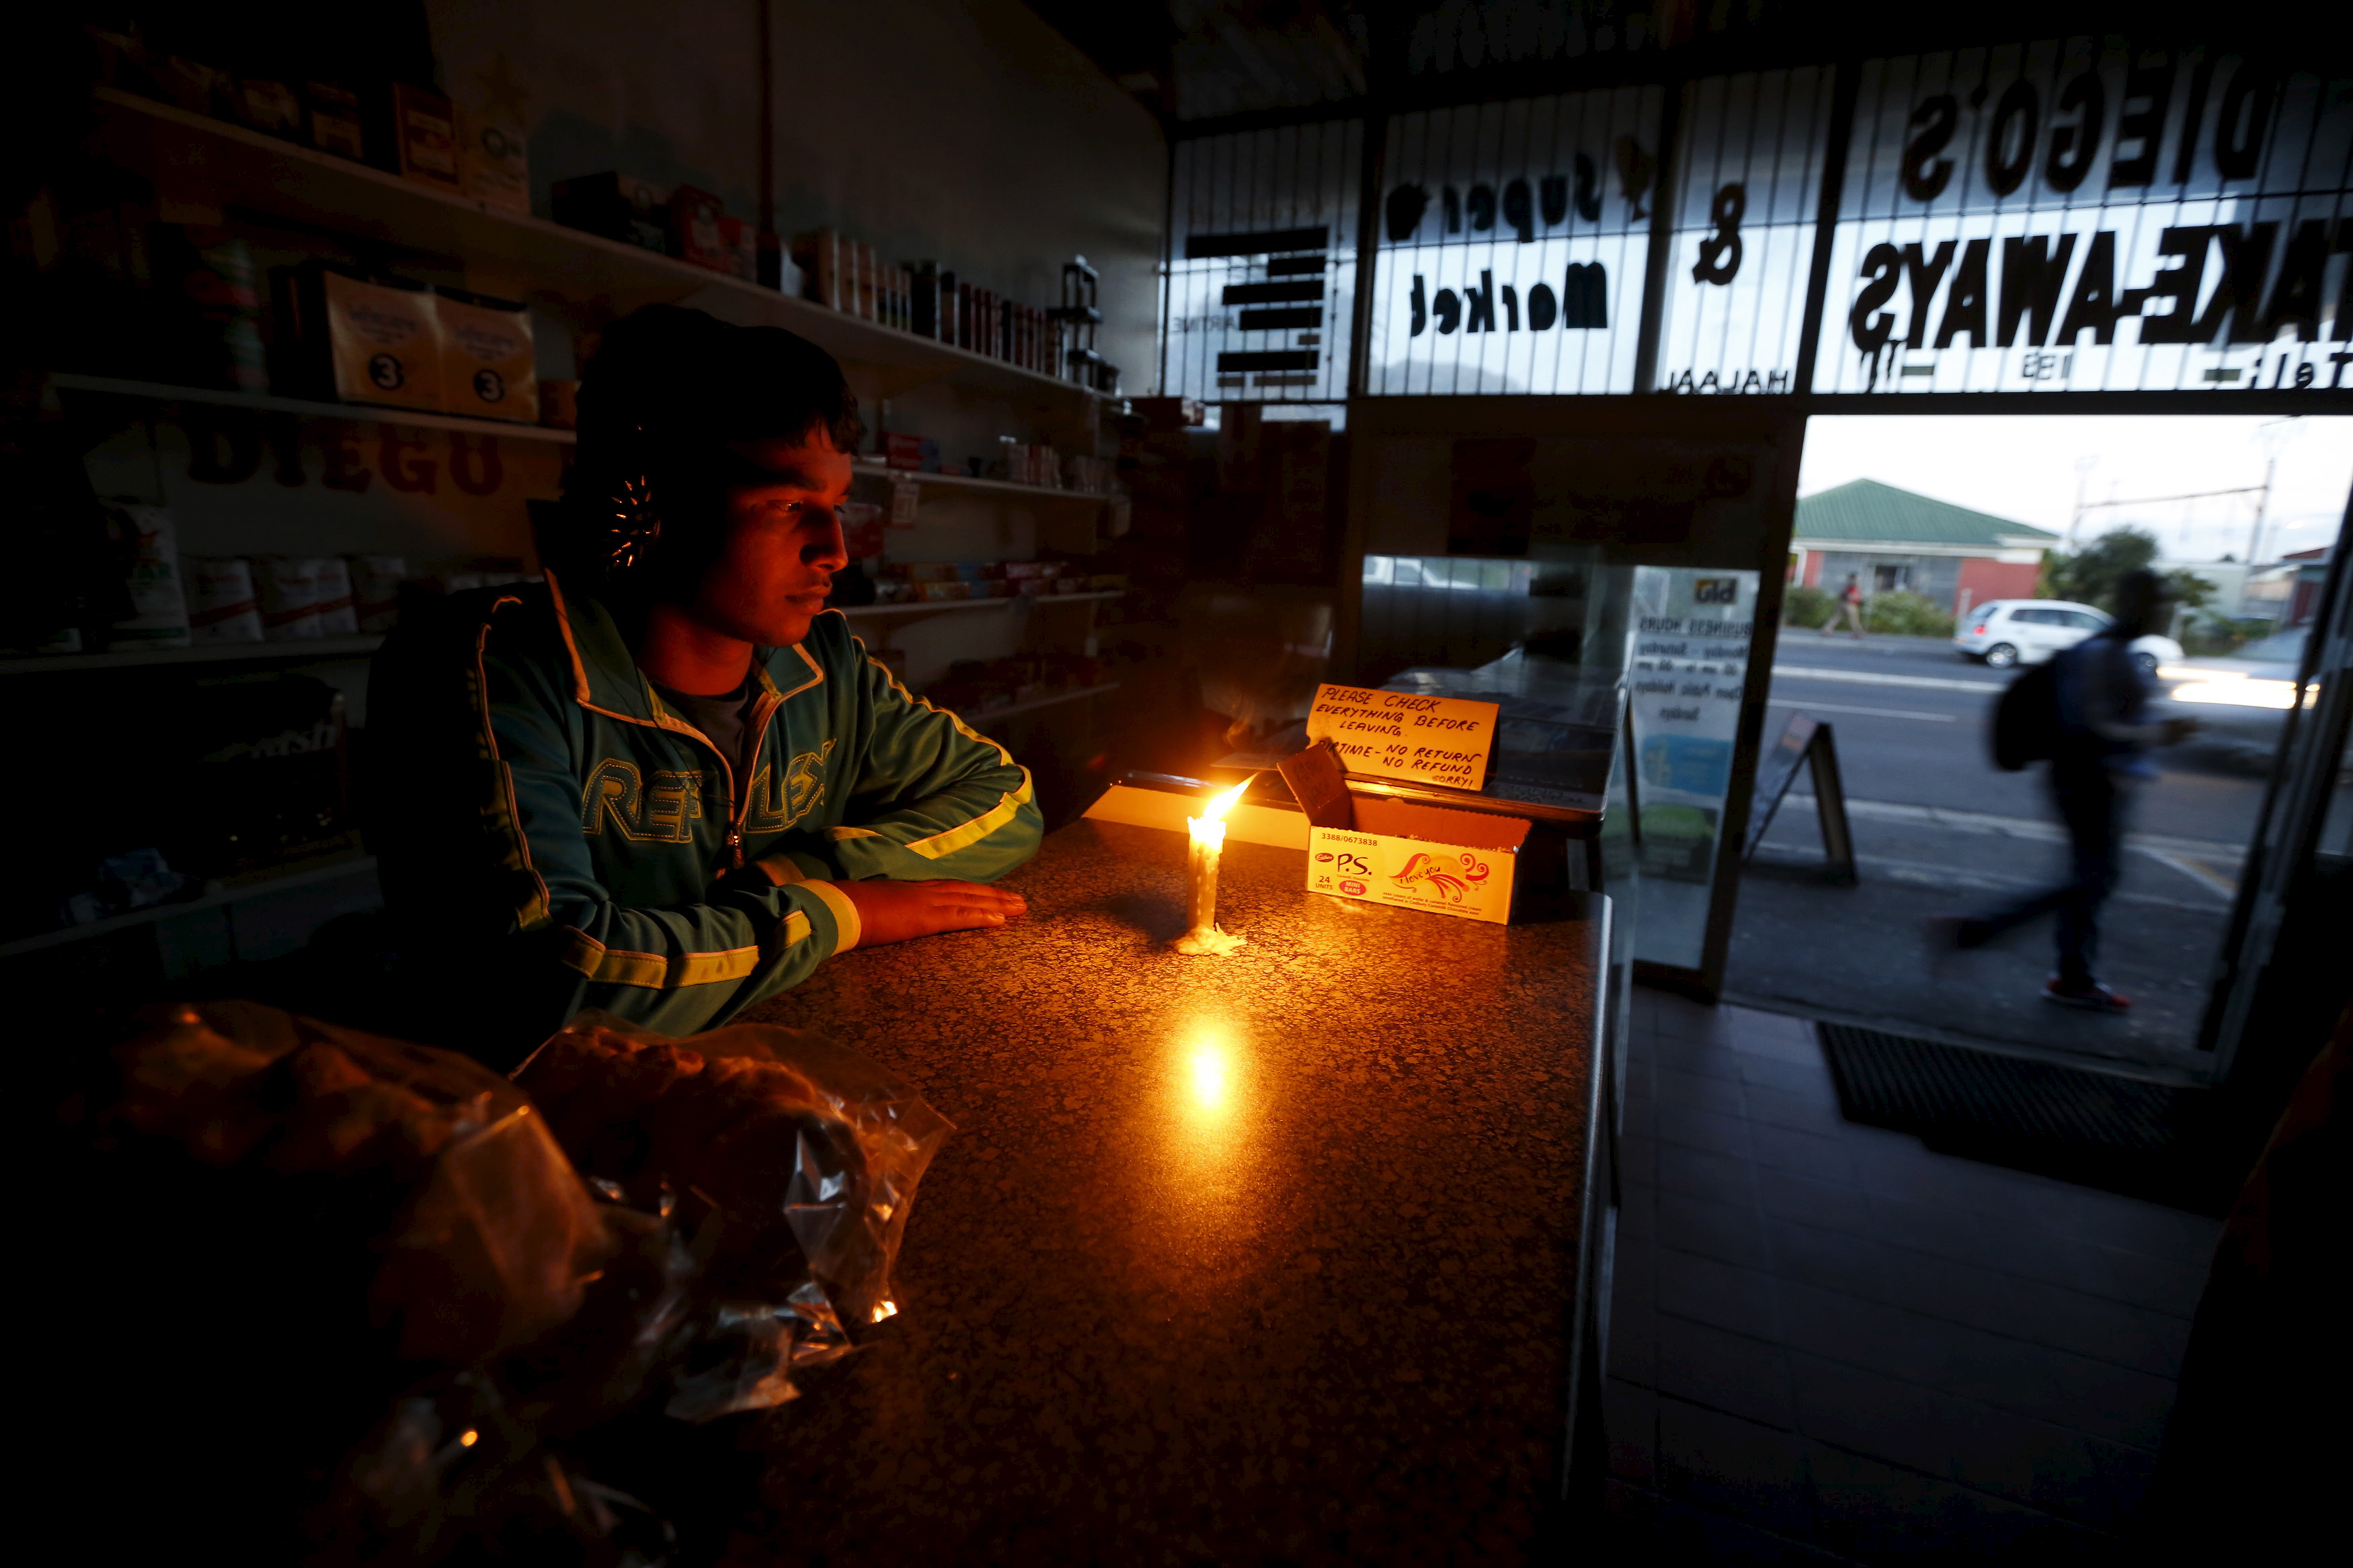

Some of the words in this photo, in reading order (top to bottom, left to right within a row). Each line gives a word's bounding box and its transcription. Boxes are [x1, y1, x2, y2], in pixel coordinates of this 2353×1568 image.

[374, 355, 401, 390] 3
[480, 370, 503, 403] 3
[1321, 688, 1373, 704] PLEASE
[1384, 695, 1441, 712] CHECK
[1316, 704, 1404, 723] EVERYTHING
[1414, 715, 1480, 732] BEFORE
[1386, 744, 1408, 755] NO
[1414, 747, 1482, 764] RETURN
[1382, 757, 1404, 768] NO
[1411, 759, 1472, 775] REFUND
[1321, 833, 1378, 847] 3388/0673838
[1338, 853, 1372, 876] P.S.
[1319, 875, 1330, 883] 24
[1405, 871, 1423, 884] love
[1425, 866, 1441, 877] you
[1316, 882, 1333, 891] UNITS
[1345, 886, 1361, 895] BARS
